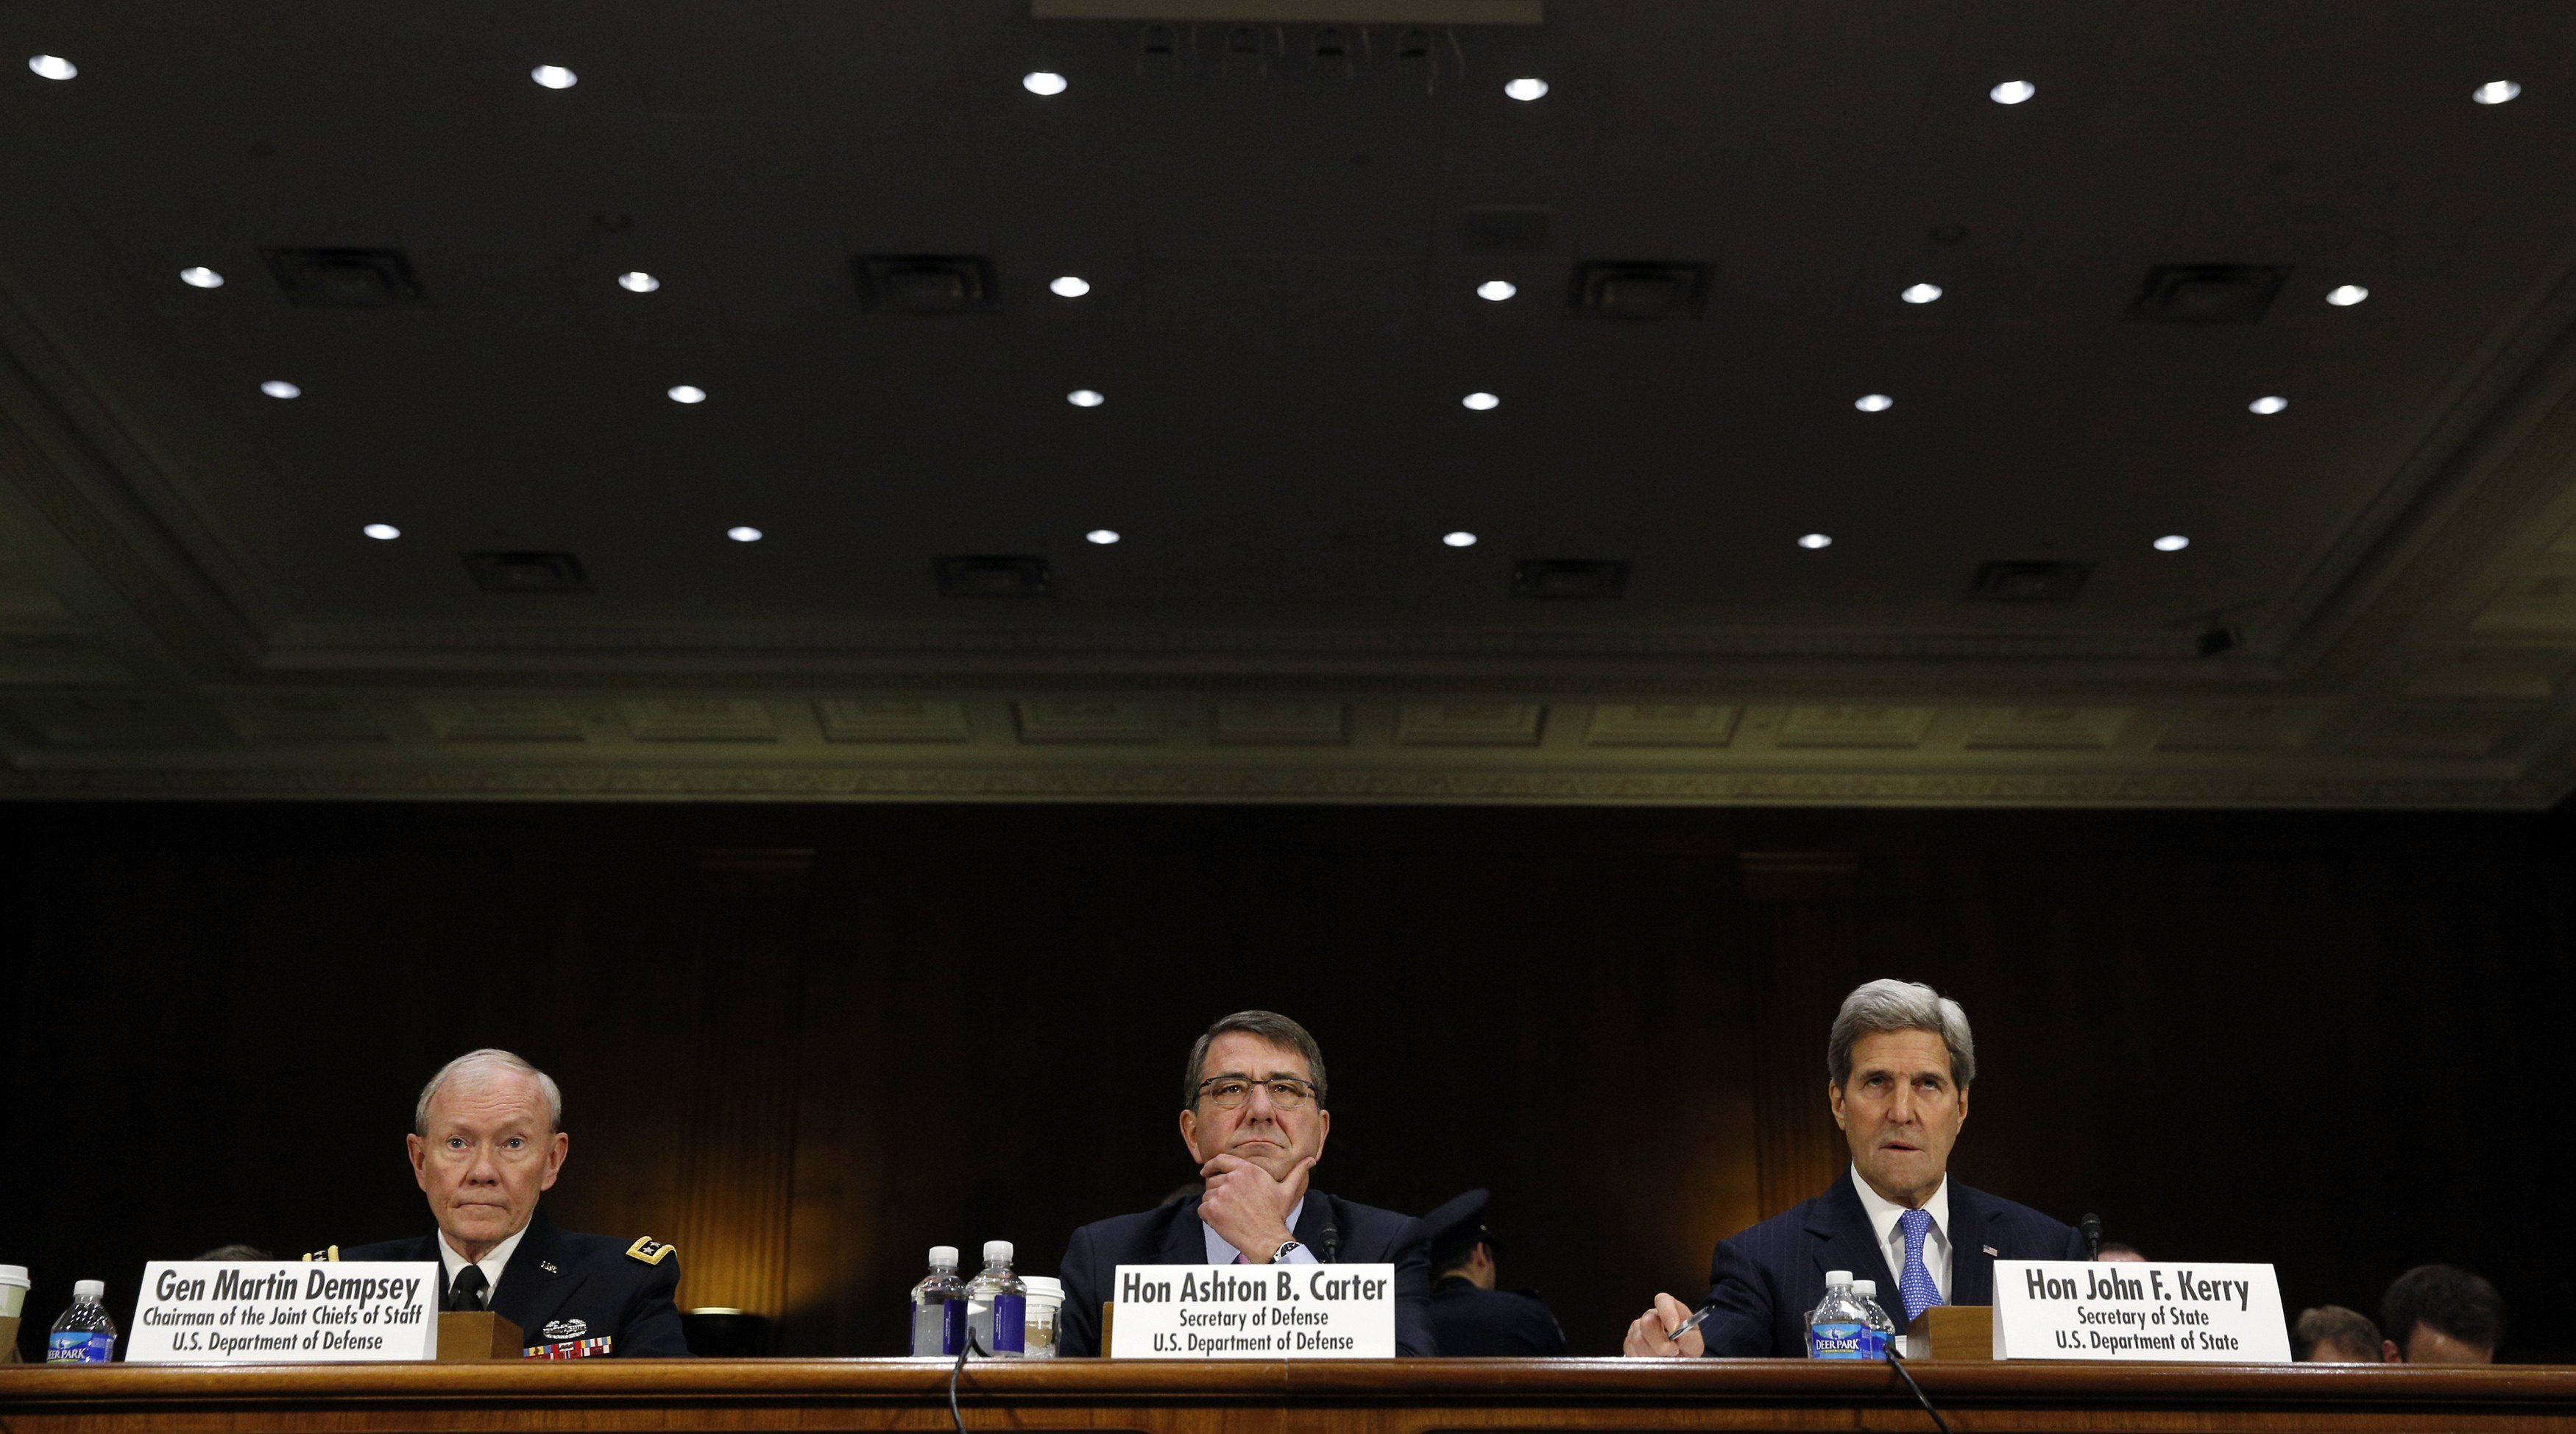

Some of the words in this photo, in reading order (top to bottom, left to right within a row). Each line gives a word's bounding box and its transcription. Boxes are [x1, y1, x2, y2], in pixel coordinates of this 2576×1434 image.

[156, 1269, 205, 1301] Gen
[212, 1270, 297, 1301] Martin
[305, 1269, 420, 1310] Dempsey
[1123, 1273, 1170, 1303] Hon
[1180, 1271, 1266, 1302] Ashton
[1277, 1271, 1300, 1301] B.
[1310, 1271, 1387, 1301] Carter
[2026, 1269, 2077, 1299] Hon
[2087, 1268, 2143, 1300] John
[2150, 1271, 2171, 1301] F.
[2178, 1271, 2248, 1311] Kerry
[144, 1307, 214, 1326] Chairman
[220, 1306, 237, 1325] of
[241, 1306, 264, 1325] the
[269, 1307, 307, 1325] Joint
[313, 1305, 358, 1324] Chiefs
[363, 1304, 380, 1324] of
[384, 1304, 422, 1324] Staff
[1180, 1309, 1246, 1331] Secretary
[1253, 1307, 1266, 1326] of
[1273, 1307, 1328, 1325] Defense
[2078, 1306, 2145, 1330] Secretary
[2151, 1306, 2165, 1324] of
[2170, 1307, 2209, 1325] State
[61, 1348, 85, 1359] PARK
[173, 1332, 202, 1350] U.S.
[208, 1332, 297, 1356] Department
[302, 1330, 319, 1349] of
[323, 1329, 382, 1349] Defense
[1154, 1333, 1181, 1352] U.S.
[1189, 1333, 1271, 1356] Department
[1277, 1331, 1291, 1350] of
[1297, 1330, 1353, 1349] Defense
[1816, 1340, 1835, 1350] DEER
[1836, 1339, 1859, 1349] PARK
[2056, 1331, 2086, 1349] U.S.
[2090, 1331, 2175, 1354] Department
[2181, 1330, 2195, 1349] of
[2200, 1332, 2238, 1350] State
